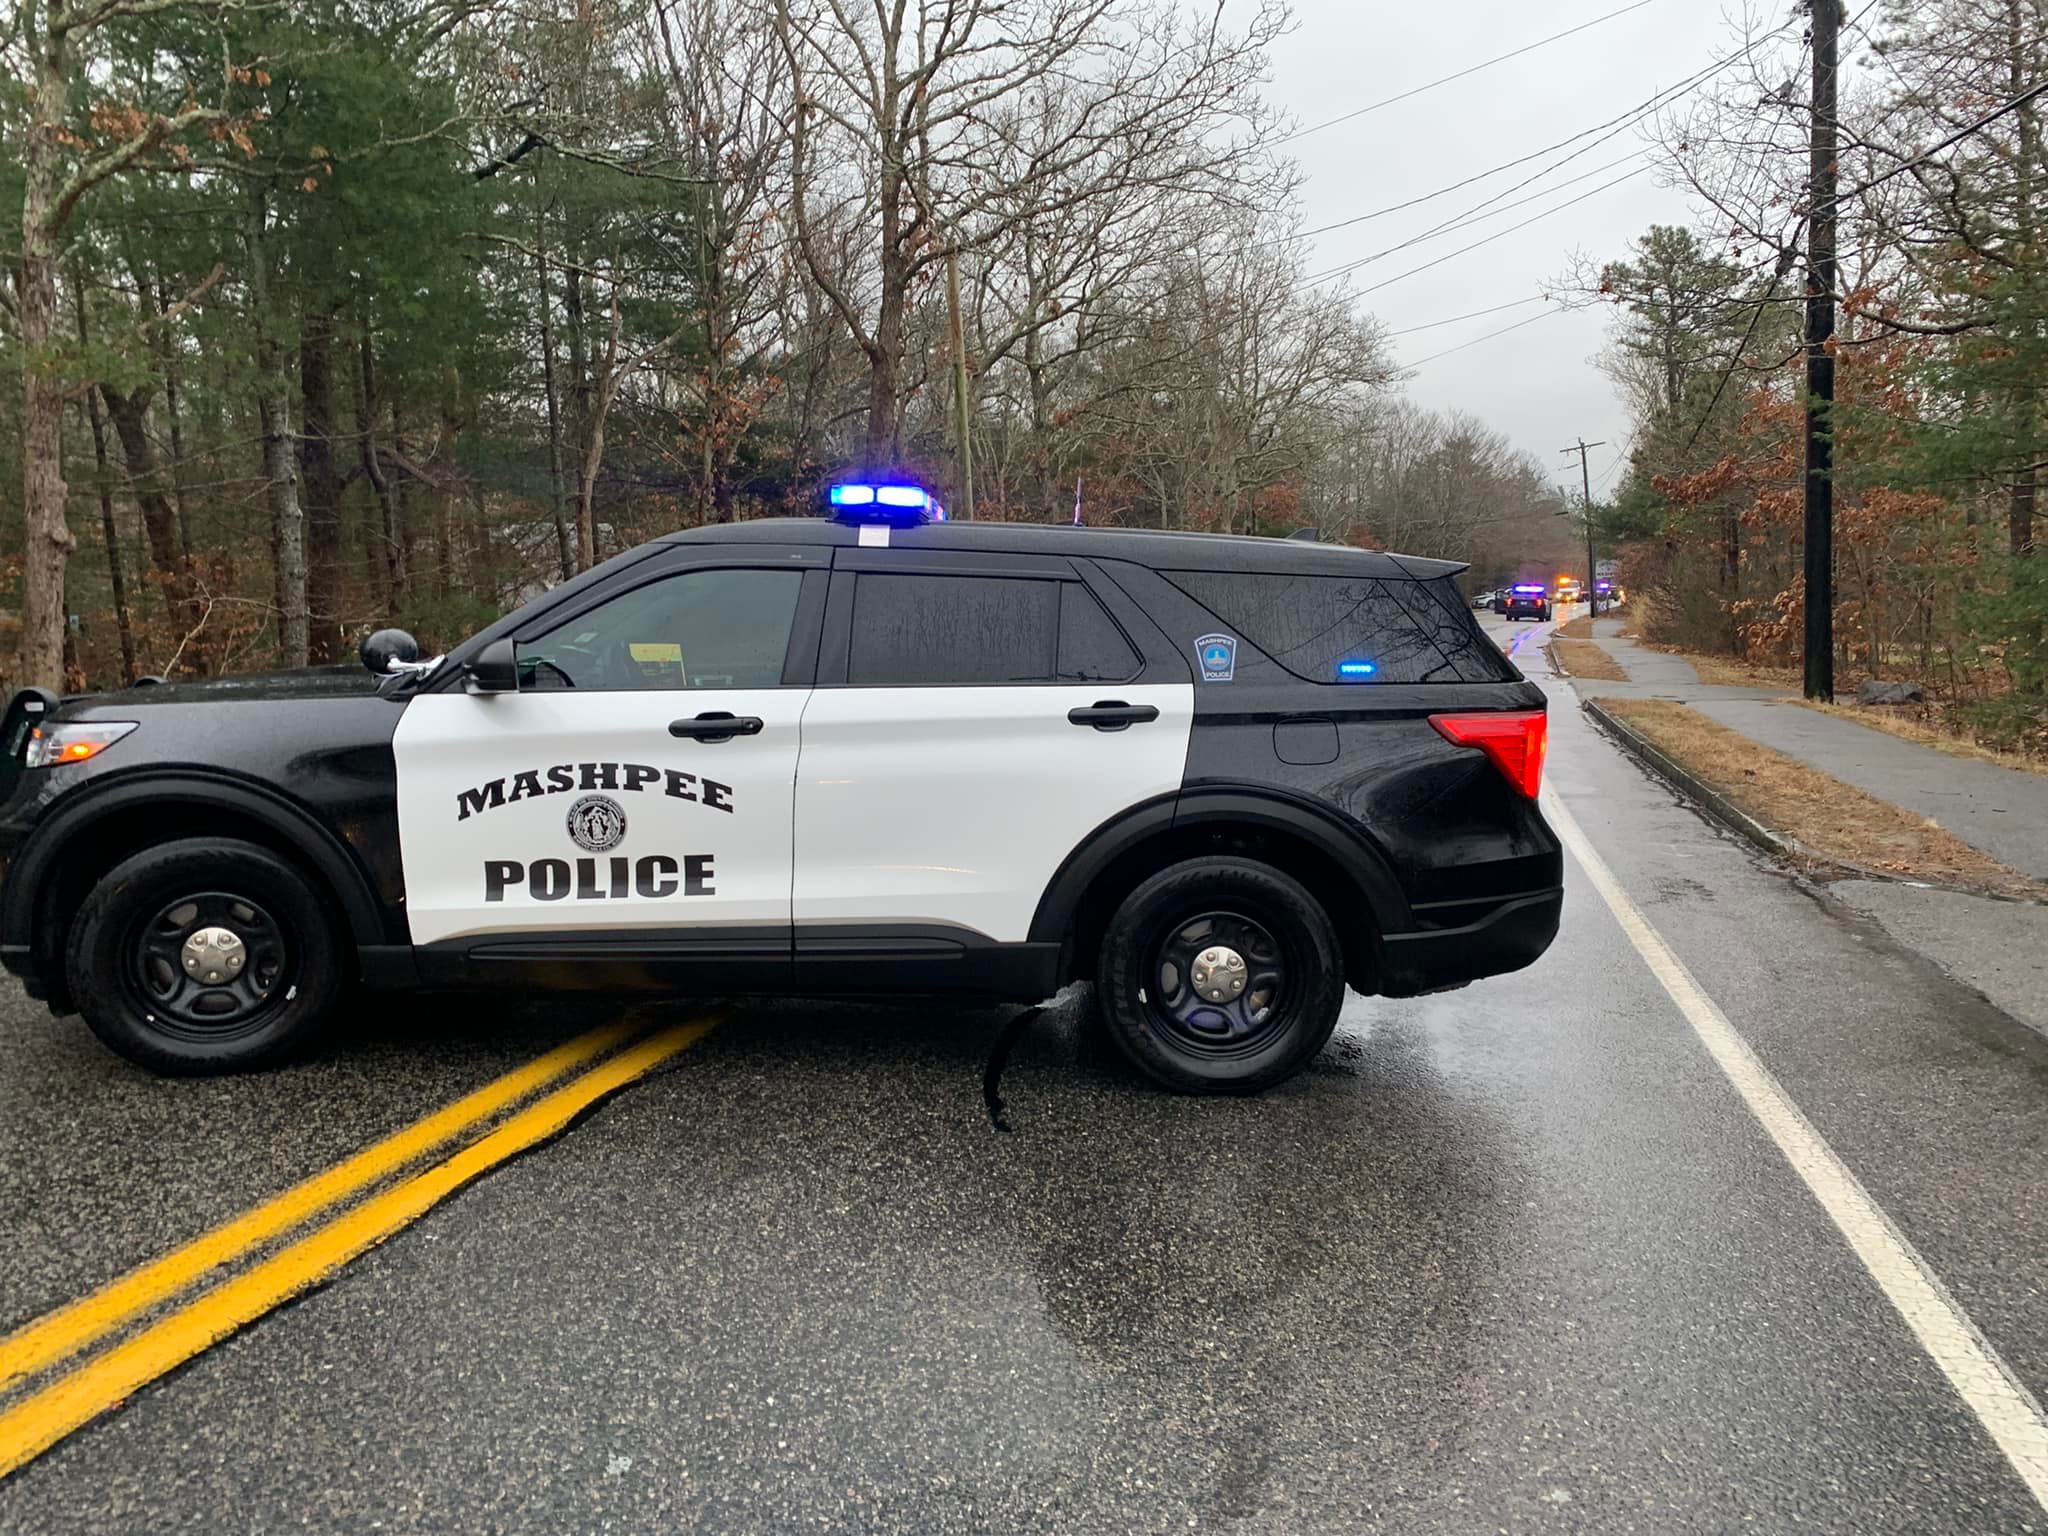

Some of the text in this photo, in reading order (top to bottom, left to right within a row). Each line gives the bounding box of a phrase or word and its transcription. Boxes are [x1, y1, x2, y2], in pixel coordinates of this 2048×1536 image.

[1198, 638, 1232, 646] MASHPEE
[457, 763, 734, 821] MASHPEE
[484, 854, 716, 902] POLICE
